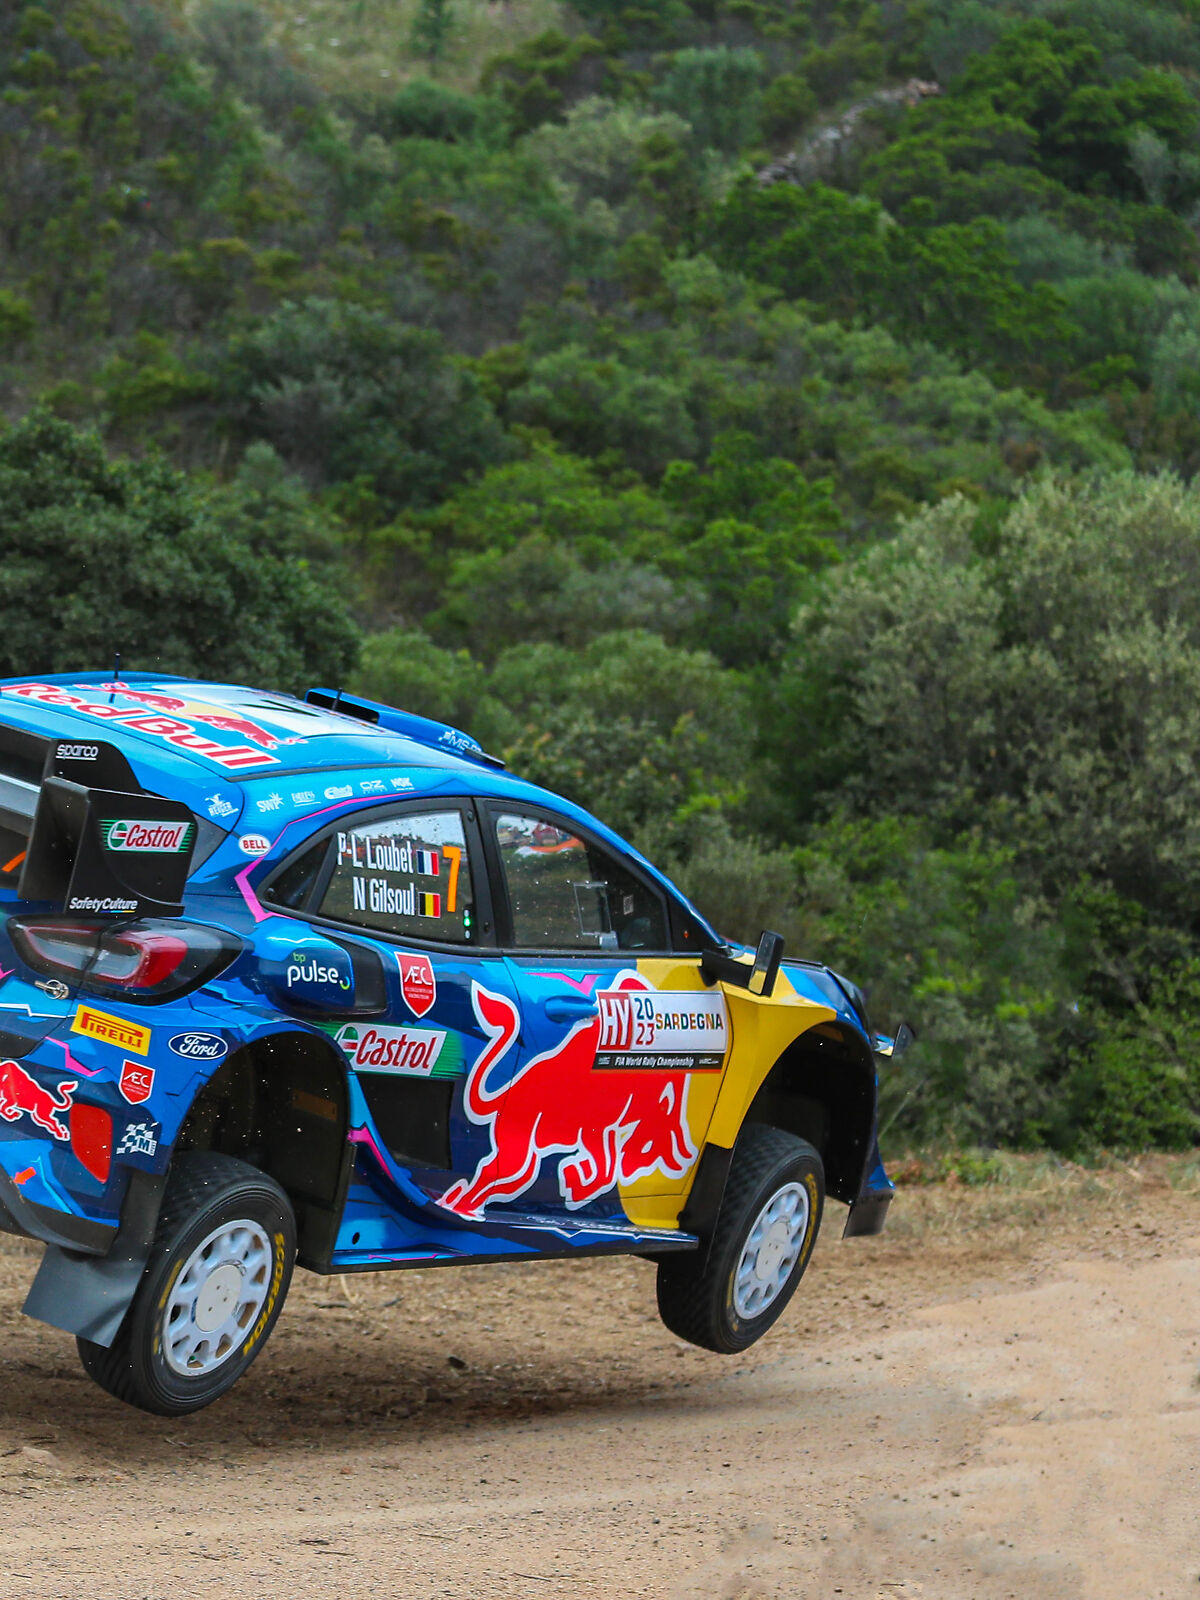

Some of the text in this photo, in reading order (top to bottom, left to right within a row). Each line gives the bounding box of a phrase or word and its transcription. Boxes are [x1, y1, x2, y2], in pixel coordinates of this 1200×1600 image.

[1, 683, 152, 720] Red
[118, 716, 280, 768] Bull
[56, 744, 98, 759] sparco
[360, 780, 384, 790] OZ
[125, 824, 183, 848] Castrol
[243, 840, 267, 849] BELL
[337, 831, 414, 873] P-L Loubet
[442, 845, 461, 913] 7
[69, 897, 138, 912] SafetyCulture
[353, 876, 415, 916] N Gilsoul
[293, 952, 306, 963] bp
[287, 960, 339, 987] pulse
[634, 998, 654, 1020] 20
[80, 1012, 144, 1048] PIRELLI
[600, 998, 629, 1046] HY
[655, 1013, 724, 1030] SARDEGNA
[635, 1022, 655, 1045] 23
[179, 1035, 219, 1056] Ford
[356, 1030, 438, 1069] Castrol
[615, 1057, 625, 1066] FIA
[626, 1057, 642, 1066] World
[643, 1057, 657, 1068] Rally
[658, 1057, 694, 1068] Championship
[243, 1233, 285, 1355] SCORPION
